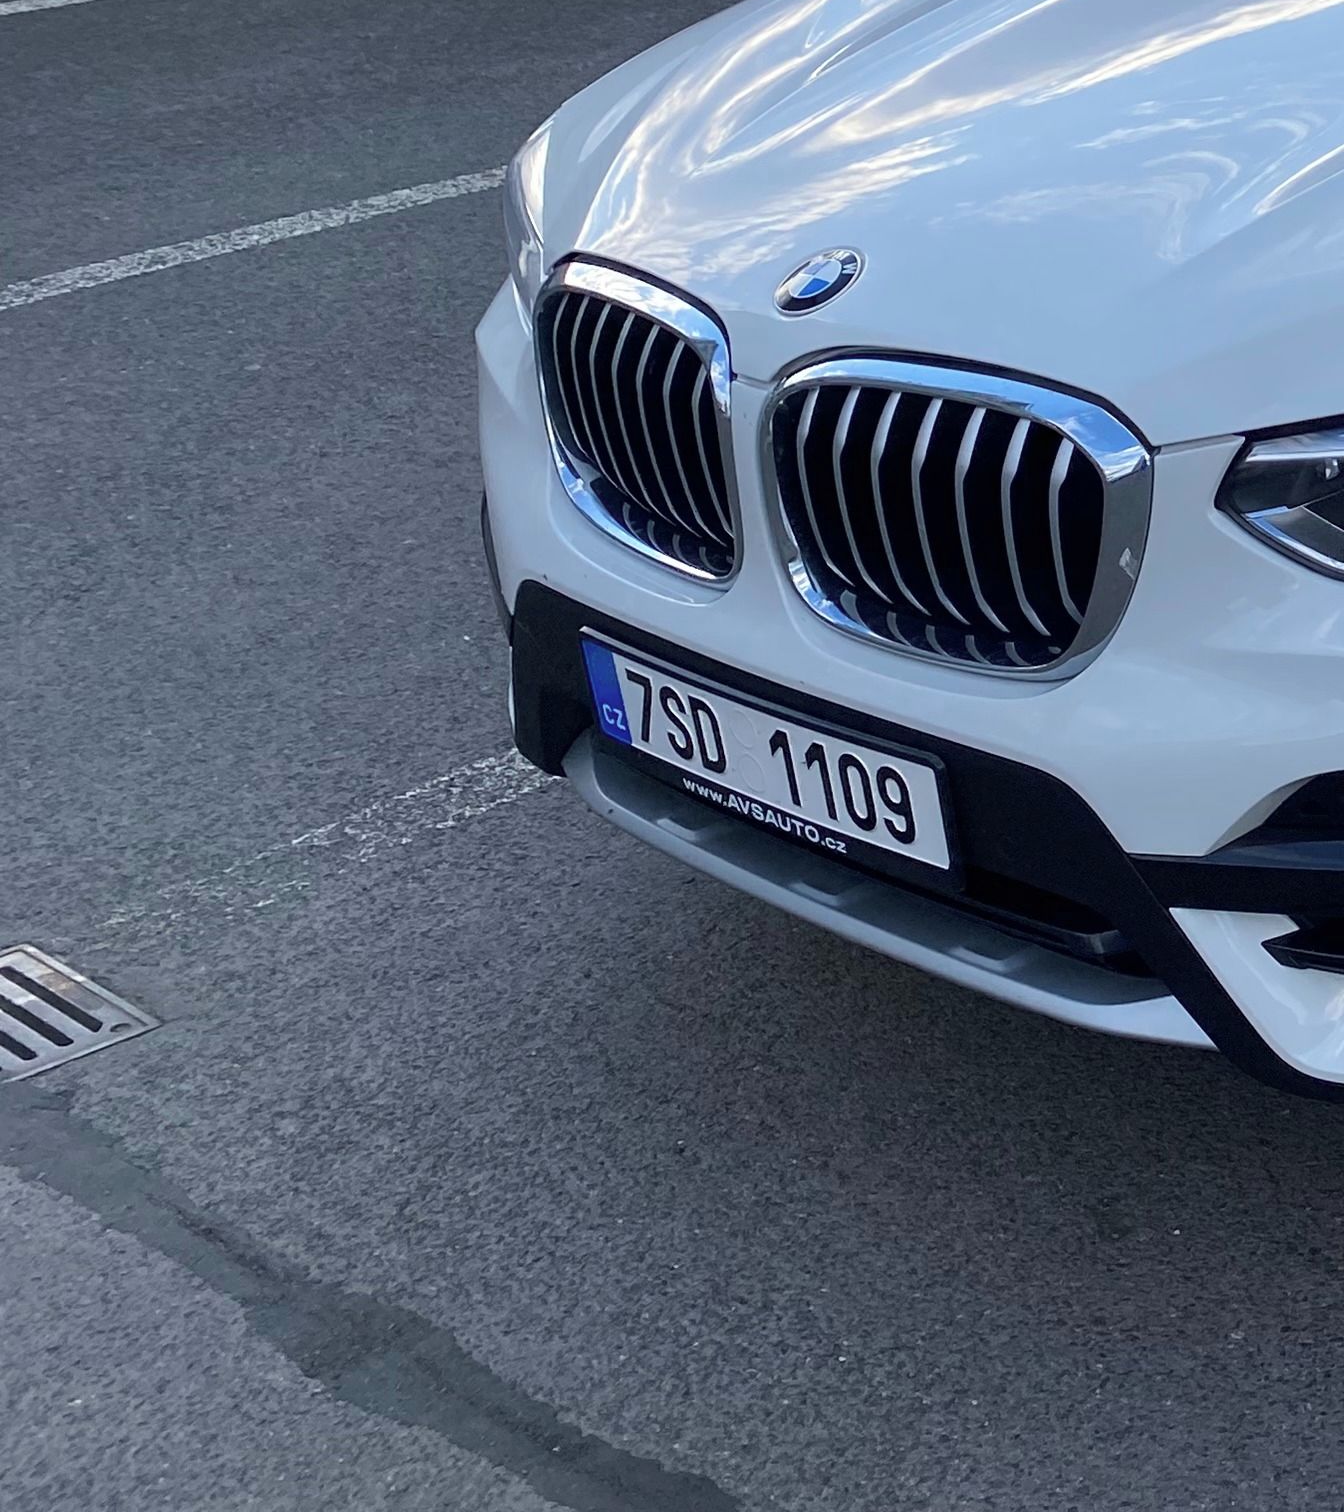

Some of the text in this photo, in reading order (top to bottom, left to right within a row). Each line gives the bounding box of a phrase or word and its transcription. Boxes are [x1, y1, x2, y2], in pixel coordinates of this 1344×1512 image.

[602, 703, 627, 732] CZ
[625, 667, 917, 845] 7SD 1109
[682, 777, 848, 855] www.AVSAUTO.cz
